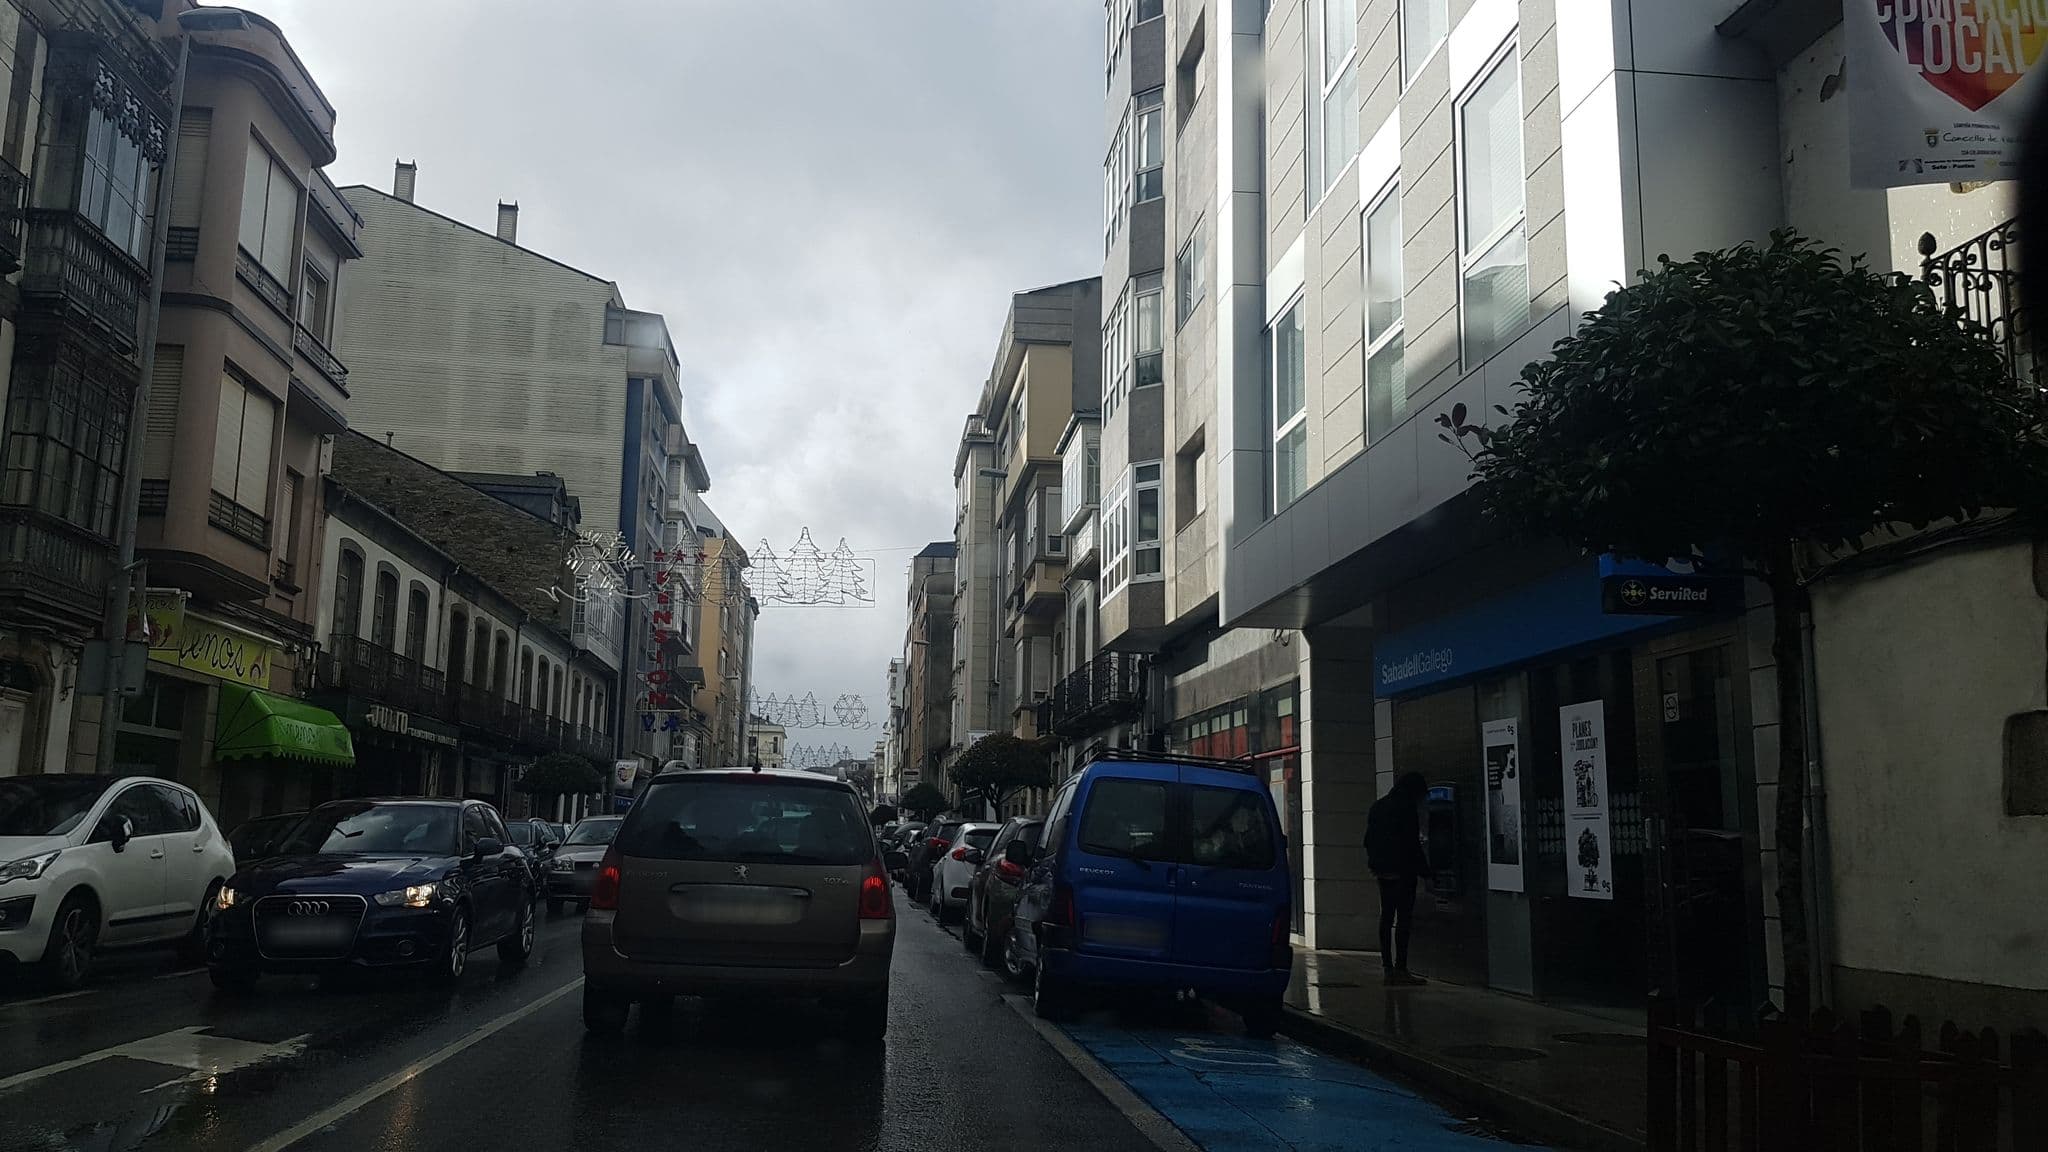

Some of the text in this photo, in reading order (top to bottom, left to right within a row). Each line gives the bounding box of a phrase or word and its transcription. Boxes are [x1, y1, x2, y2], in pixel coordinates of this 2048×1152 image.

[1876, 0, 2048, 27] COMERCI
[1894, 14, 2026, 75] LOCAL
[1649, 586, 1708, 602] ServiRed
[1382, 648, 1453, 685] SabadellGallego
[1572, 720, 1591, 738] PLANES
[1079, 867, 1115, 876] PEUGEOT
